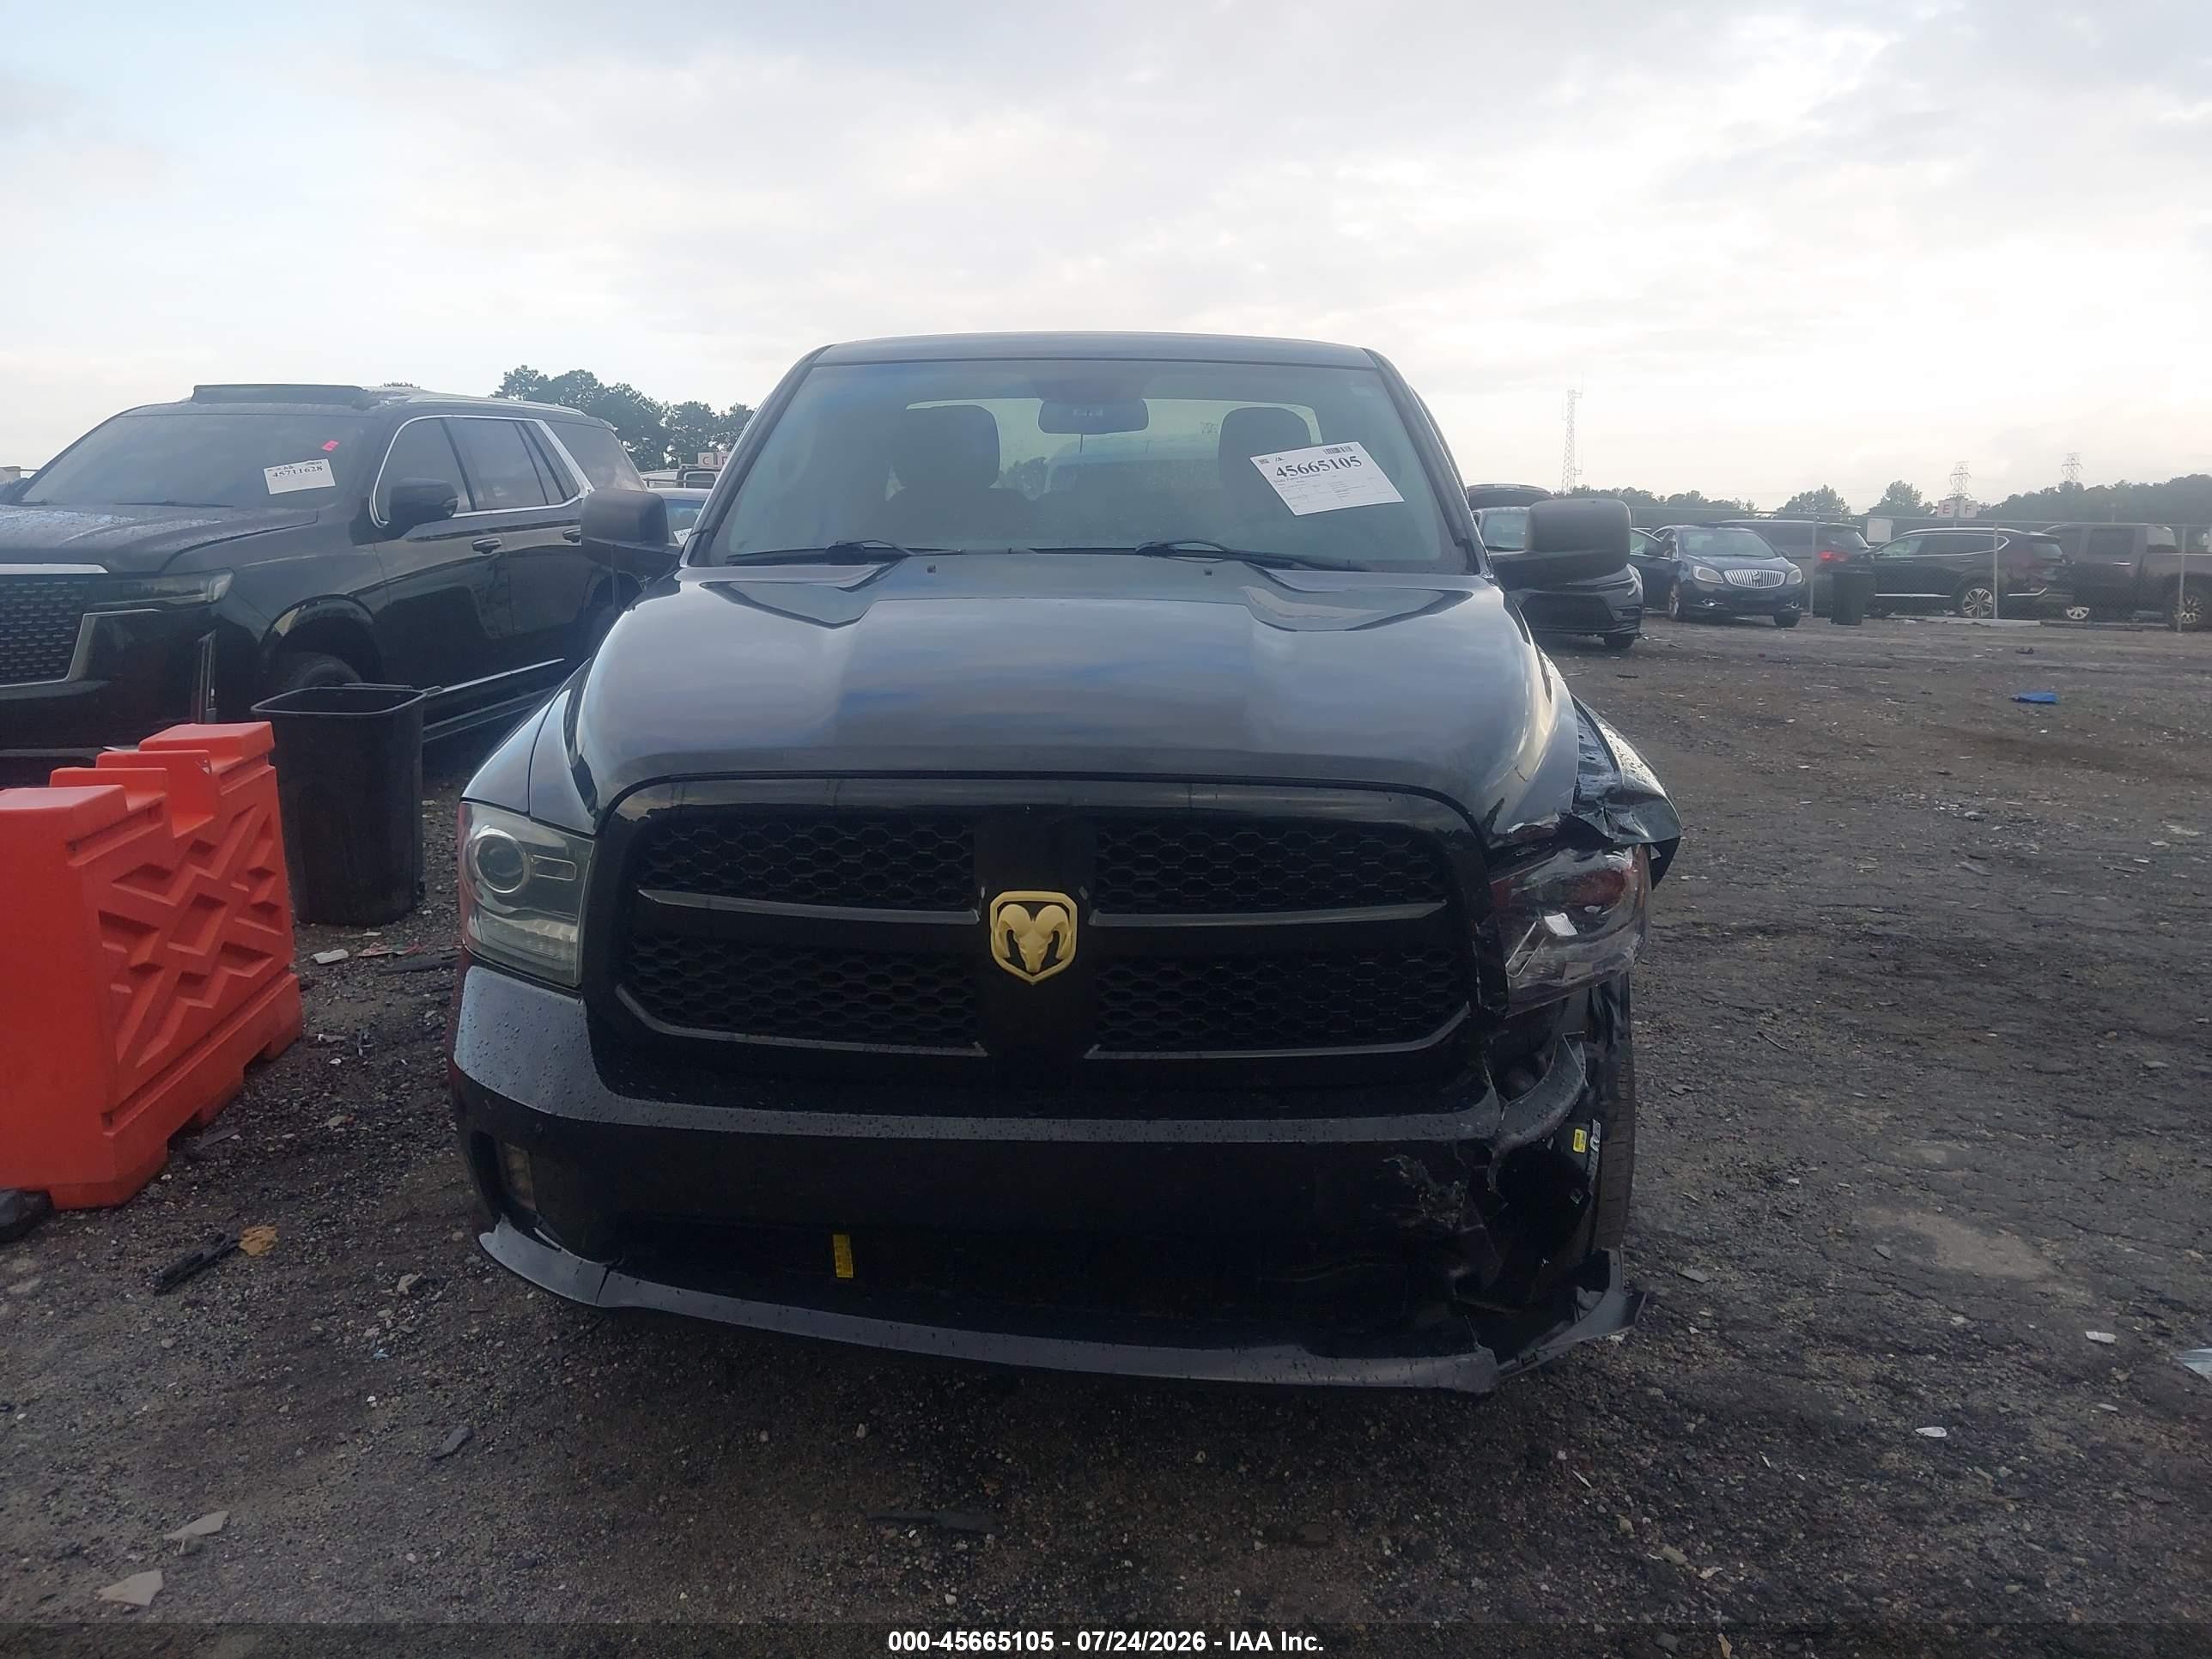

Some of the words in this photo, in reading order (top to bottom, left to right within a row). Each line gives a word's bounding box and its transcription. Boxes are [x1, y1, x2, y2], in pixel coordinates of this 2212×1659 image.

[272, 465, 324, 477] 45711628
[1276, 455, 1363, 477] 45665105
[1942, 504, 1950, 514] E
[1964, 504, 1972, 514] F
